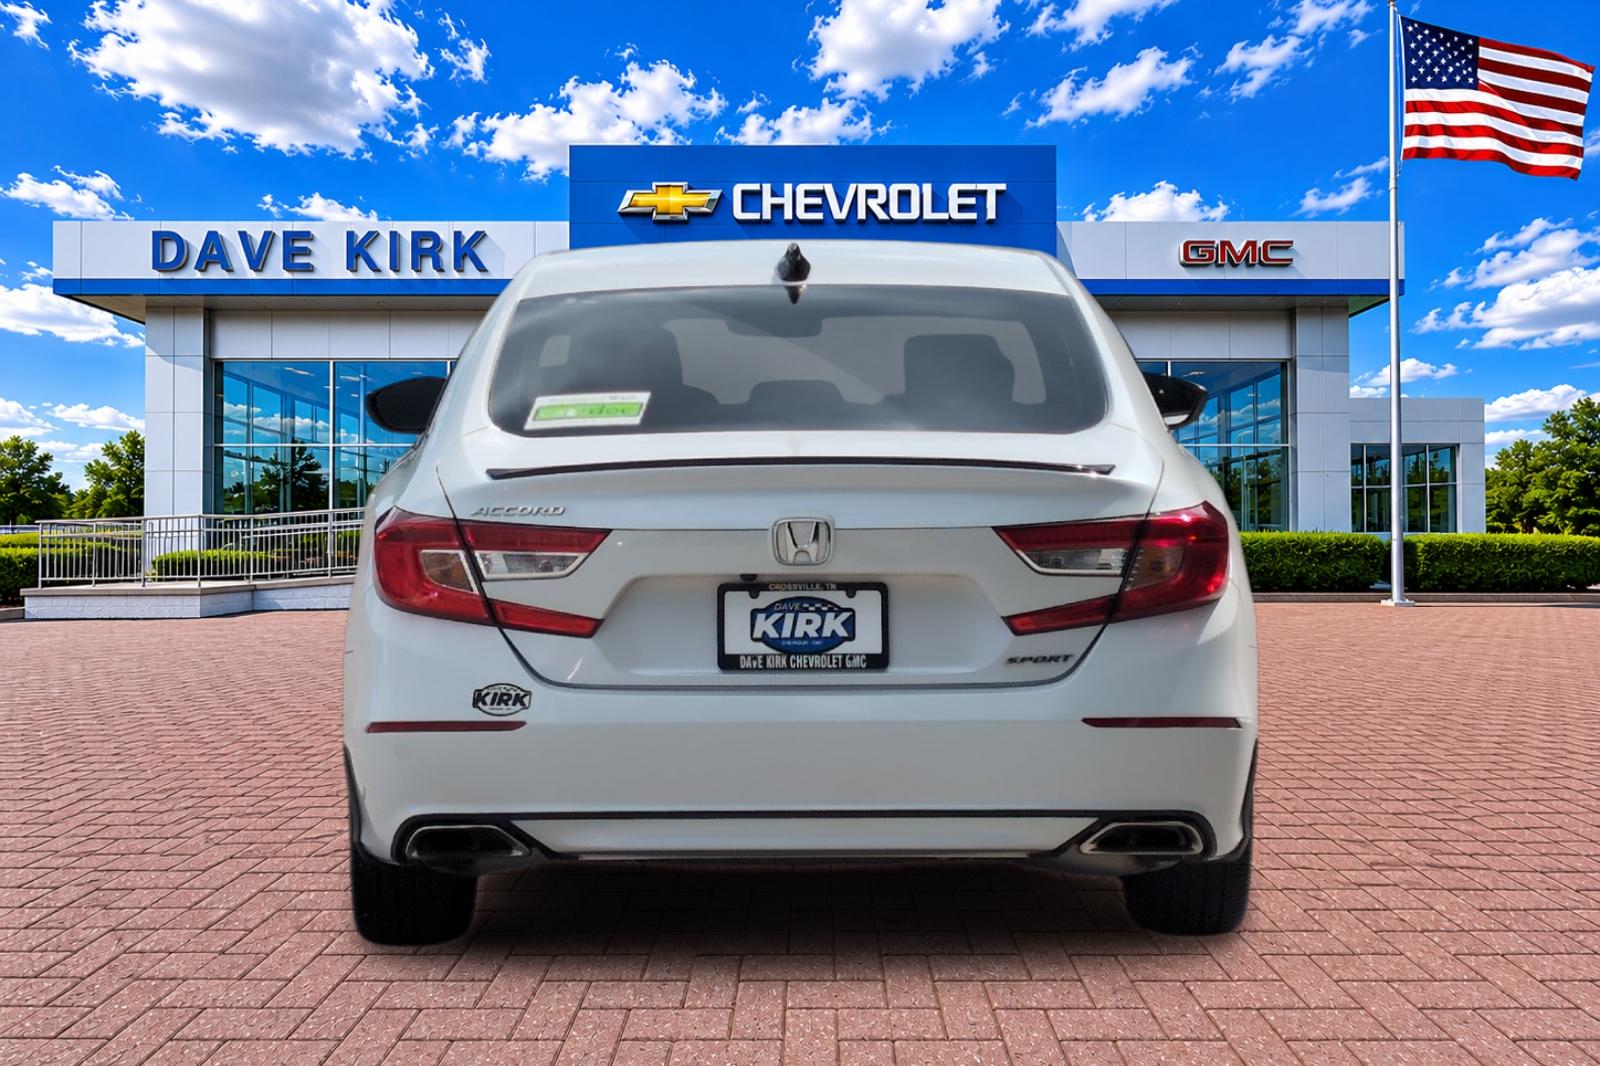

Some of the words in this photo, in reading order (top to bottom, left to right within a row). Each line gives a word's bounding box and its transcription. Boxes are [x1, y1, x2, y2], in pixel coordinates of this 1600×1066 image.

[733, 183, 1007, 223] CHEVROLET
[151, 230, 315, 273] DAVE
[346, 230, 488, 273] KIRK
[1180, 239, 1295, 267] GMC
[470, 506, 566, 517] ACCORD
[774, 603, 800, 611] DAVE
[752, 611, 853, 639] KIRK
[739, 655, 763, 669] DAVE
[766, 655, 787, 669] KIRK
[789, 655, 842, 669] CHEVROLET
[845, 655, 867, 669] GMC
[1007, 654, 1074, 665] SPORT
[475, 691, 530, 706] KIRK
